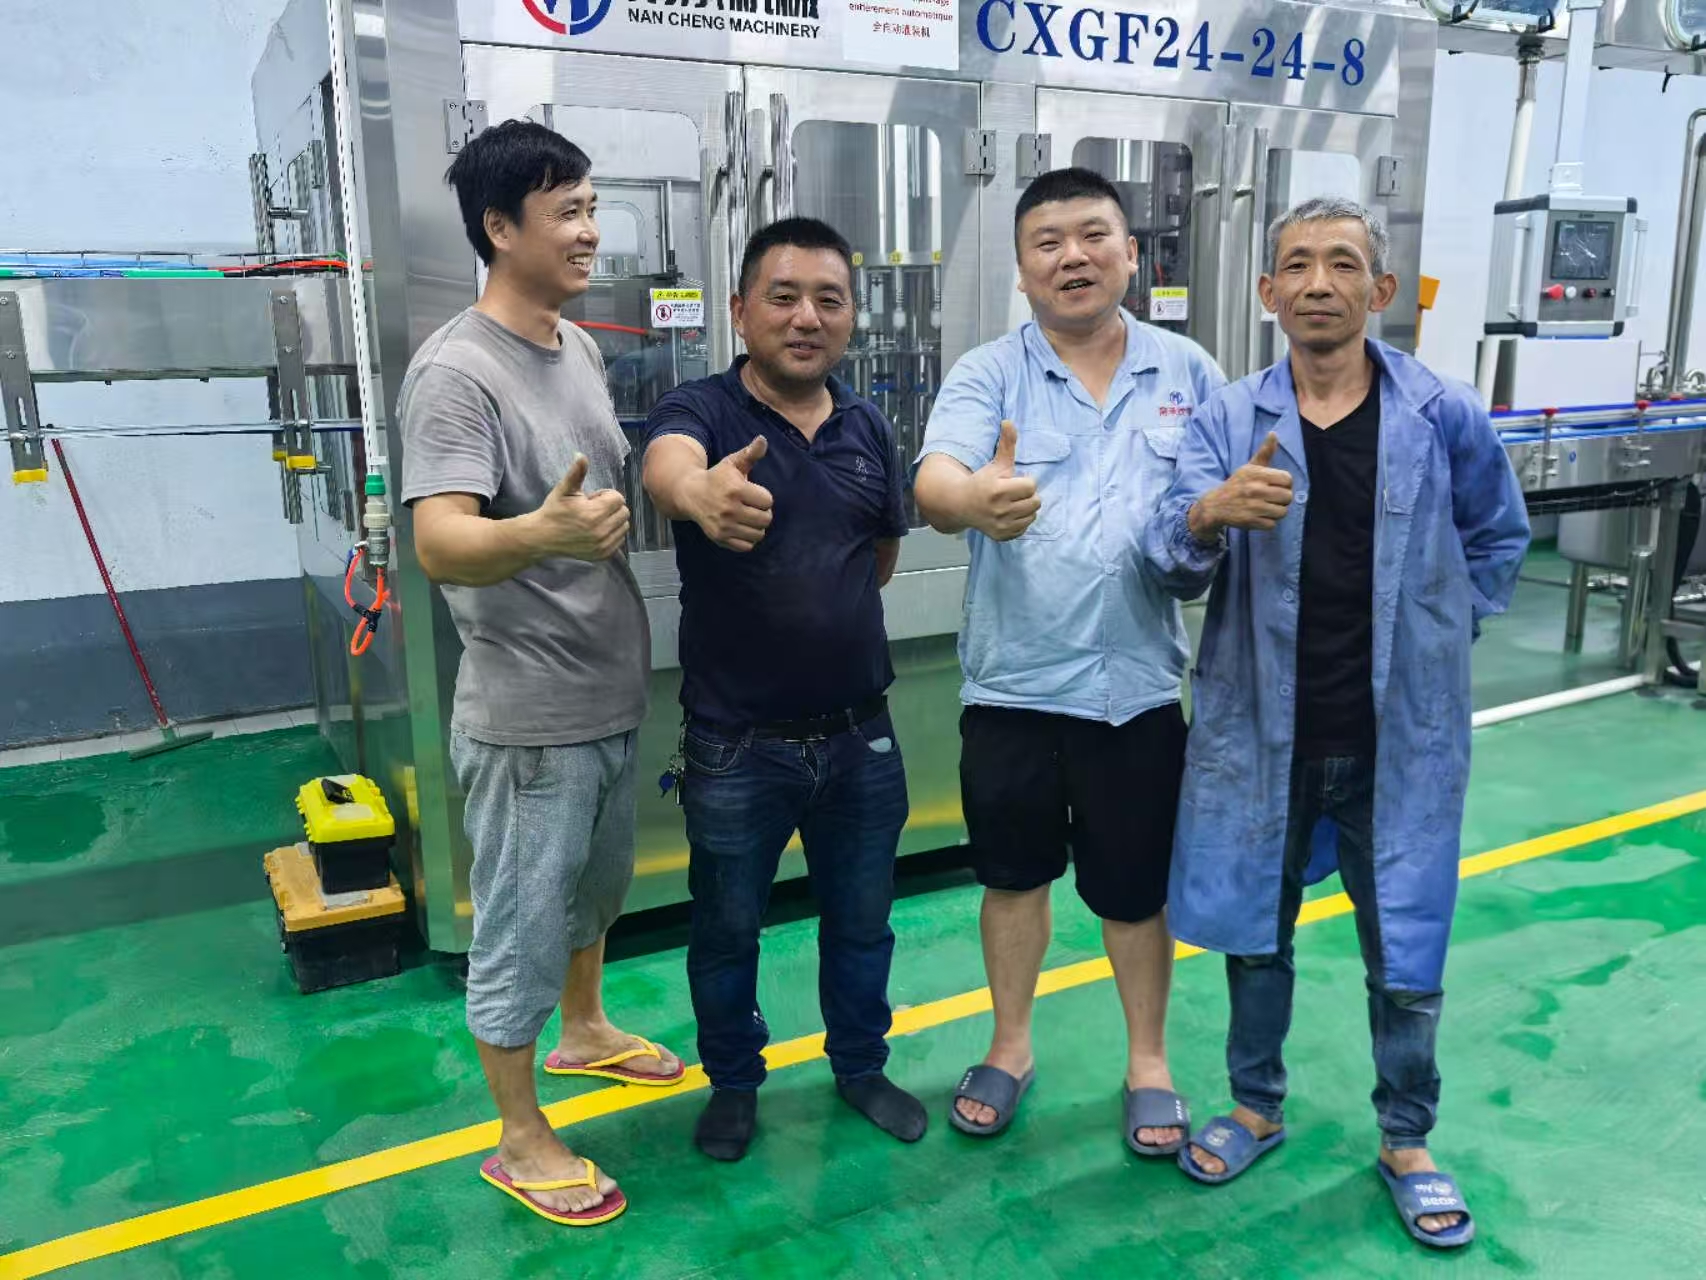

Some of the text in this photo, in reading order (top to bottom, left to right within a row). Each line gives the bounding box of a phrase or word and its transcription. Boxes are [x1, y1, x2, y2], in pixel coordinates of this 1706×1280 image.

[628, 8, 663, 24] NAN
[668, 12, 725, 30] CHENG
[730, 17, 820, 39] MACHINERY
[976, 0, 1365, 86] CXGF24-24-8
